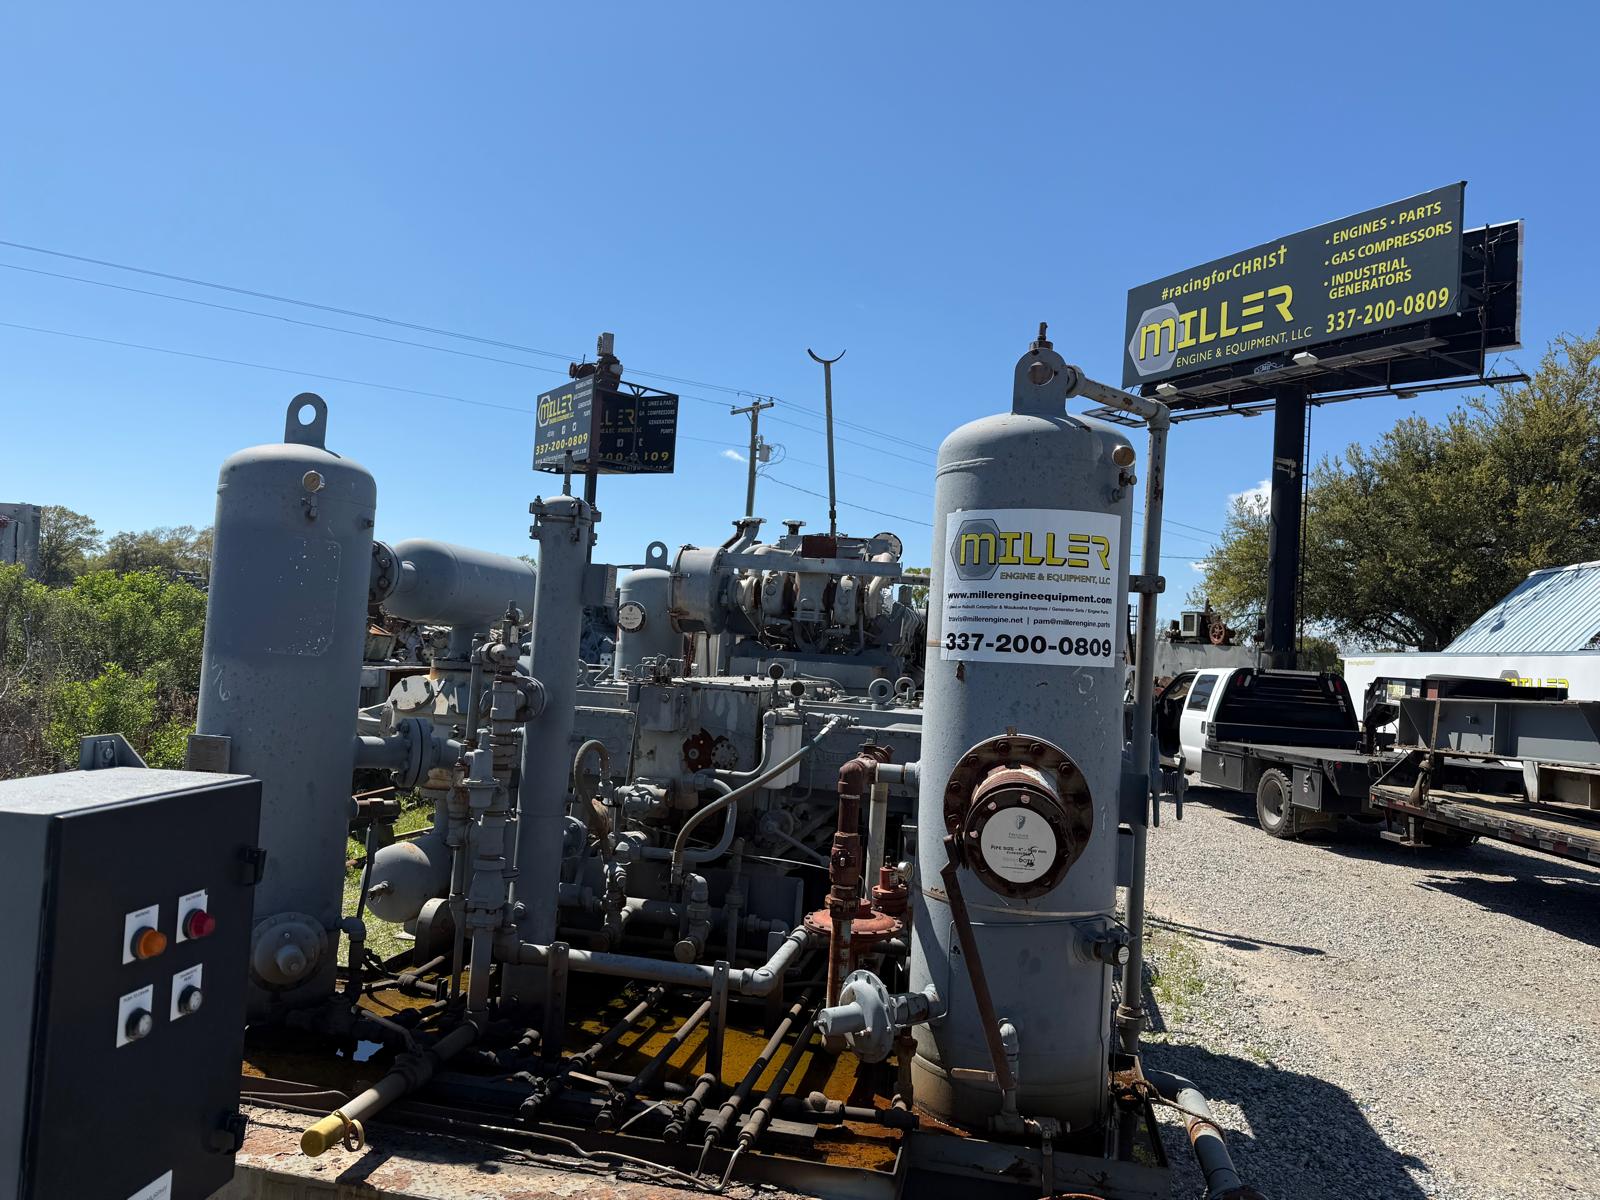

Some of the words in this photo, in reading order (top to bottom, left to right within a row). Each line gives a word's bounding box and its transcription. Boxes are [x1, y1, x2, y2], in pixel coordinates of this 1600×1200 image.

[1333, 217, 1387, 245] ENGINES
[1399, 202, 1442, 224] PARTS
[1331, 248, 1356, 266] GAS
[1357, 220, 1453, 260] COMPRESSORS
[1328, 269, 1412, 300] GENERATORS
[1331, 257, 1408, 287] INDUSTRIAL
[1139, 284, 1295, 361] MILLER
[1326, 287, 1449, 334] 337-200-0809
[1176, 347, 1213, 368] ENGINE
[1215, 346, 1222, 358] &
[1225, 331, 1288, 356] EQUIPMENT,
[1290, 325, 1313, 343] LLC
[540, 393, 573, 420] MILLER
[535, 432, 588, 456] 337-200-0809
[959, 531, 1111, 570] MILLER
[1000, 572, 1036, 581] ENGINE
[1037, 573, 1045, 581] &
[1046, 573, 1098, 585] EQUIPMENT,
[1099, 576, 1111, 585] LLC
[947, 590, 1112, 605] www.millerengineequipment.com
[948, 615, 1024, 625] travis@millerengine.net
[1033, 618, 1111, 629] pam@millerengine.parts
[945, 632, 1112, 658] 337-200-0809
